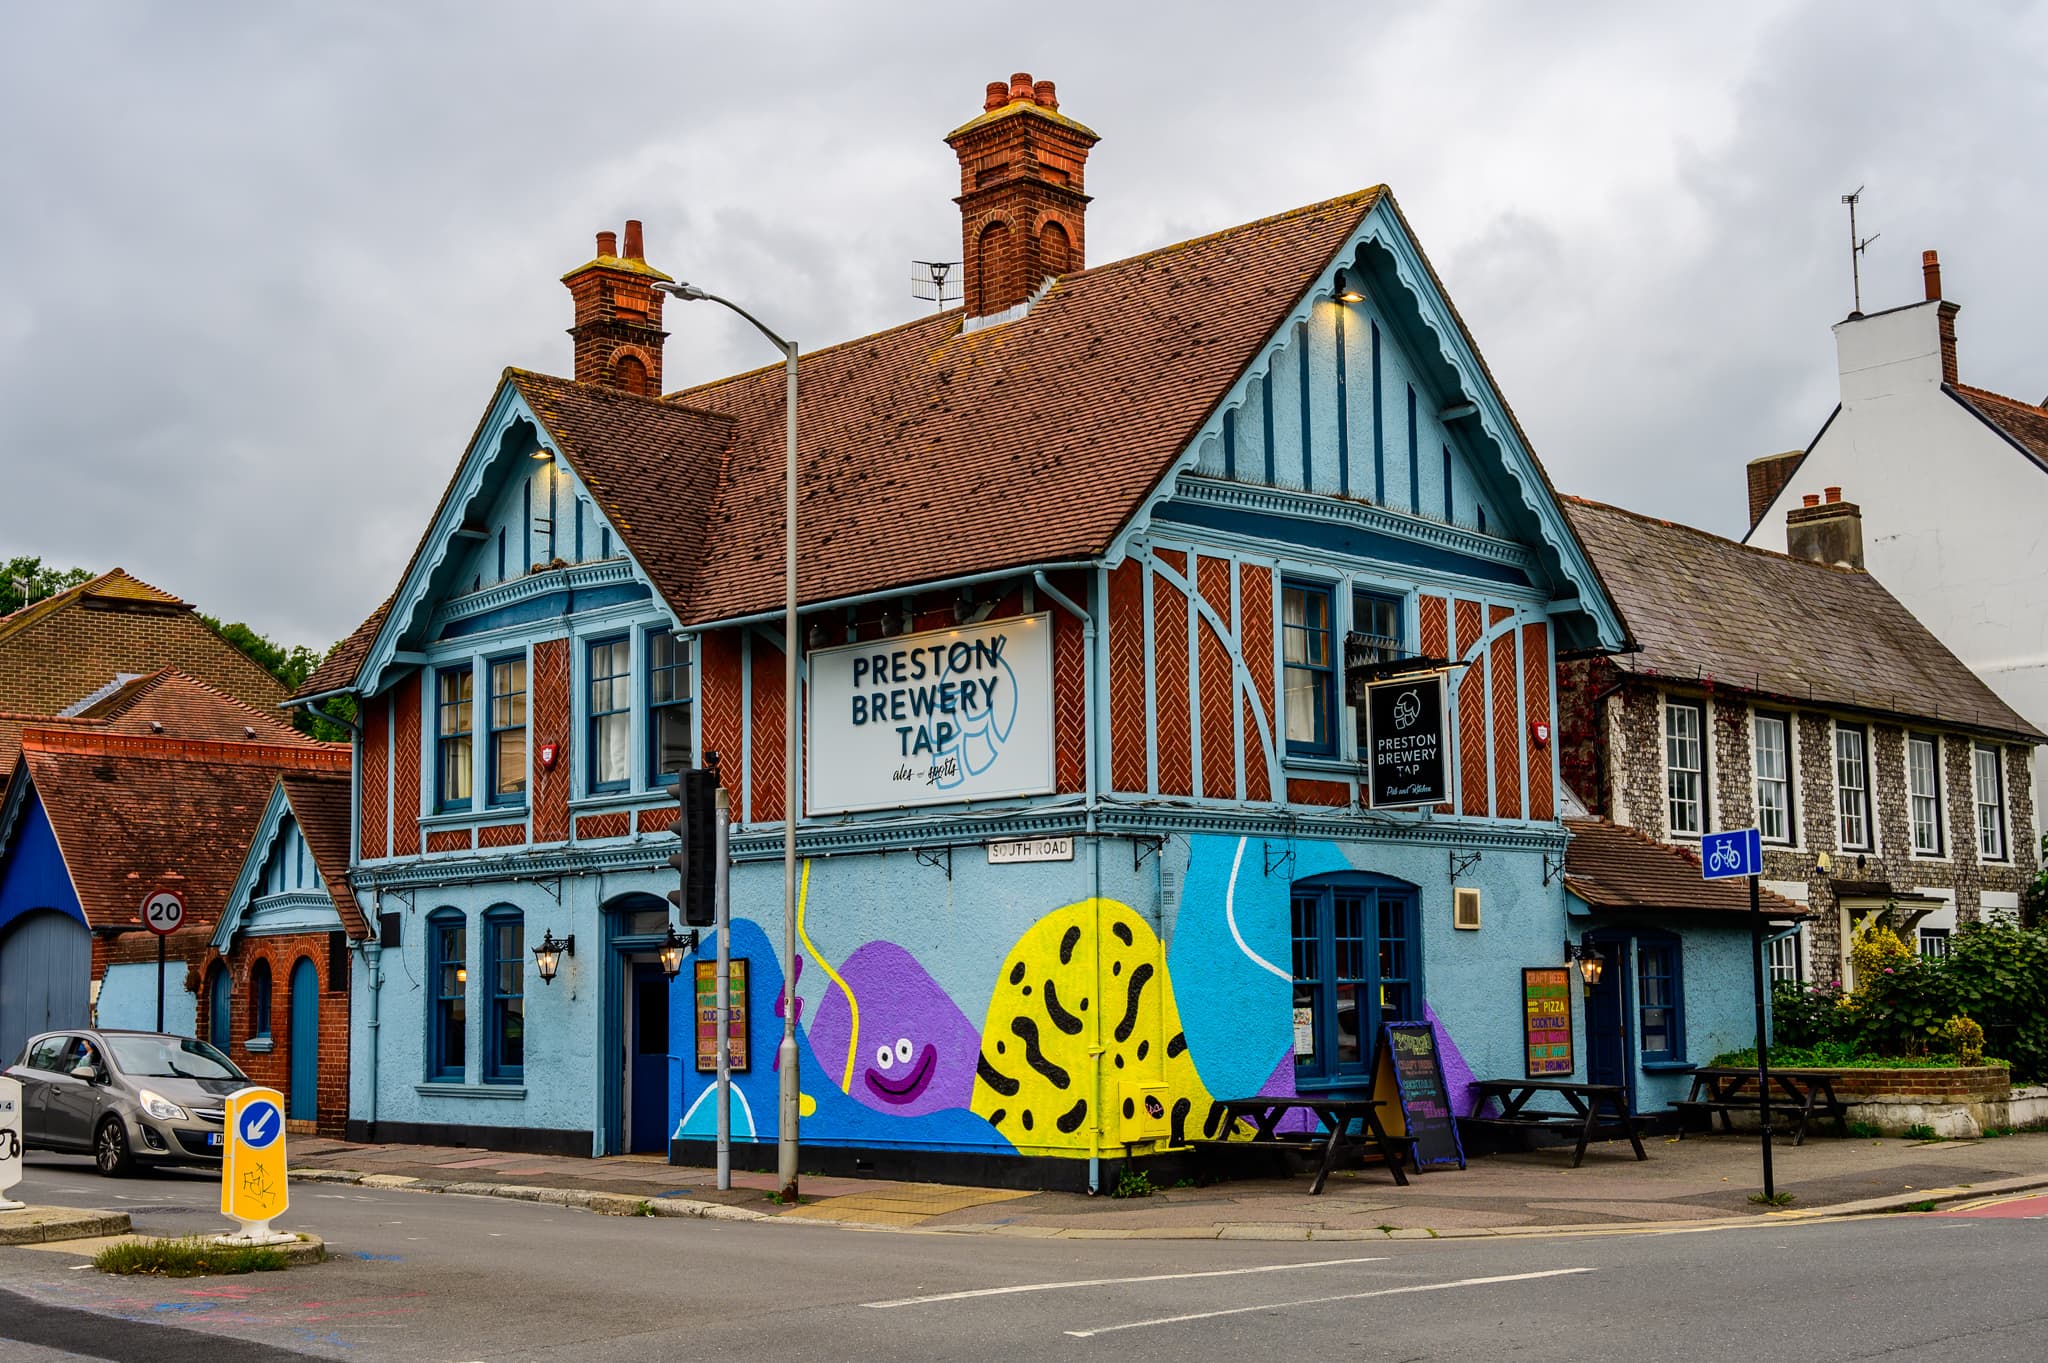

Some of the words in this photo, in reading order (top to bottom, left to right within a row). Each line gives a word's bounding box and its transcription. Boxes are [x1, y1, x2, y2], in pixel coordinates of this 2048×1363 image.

[853, 636, 999, 688] PRESTON
[852, 676, 998, 726] BREWERY
[896, 721, 954, 756] TAP
[1378, 733, 1437, 751] PRESTON
[1378, 748, 1437, 765] BREWERY
[893, 763, 914, 781] ales
[926, 757, 960, 786] sports
[1396, 764, 1420, 777] TAP
[993, 842, 1032, 857] SOUTH
[1036, 840, 1068, 855] ROAD
[150, 902, 181, 921] 20
[1543, 1001, 1565, 1013] PIZZA
[1532, 1016, 1565, 1028] COCKTAILS
[216, 1134, 224, 1144] D
